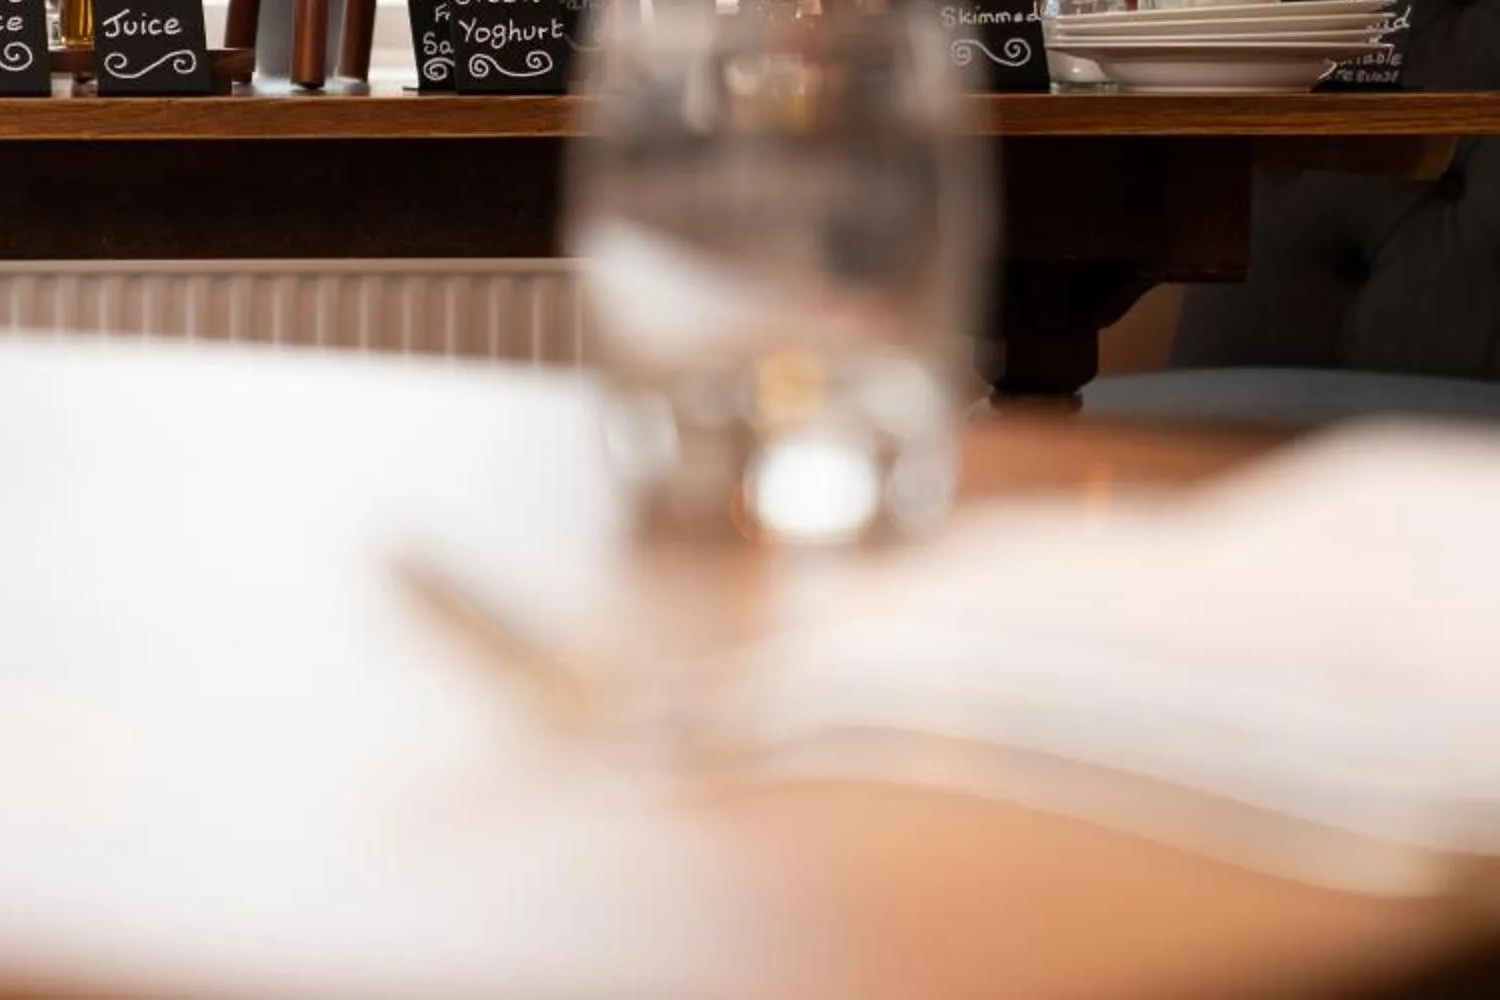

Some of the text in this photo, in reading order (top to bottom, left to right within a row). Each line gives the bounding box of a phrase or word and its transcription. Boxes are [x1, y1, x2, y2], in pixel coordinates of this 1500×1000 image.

[102, 8, 183, 38] Juice
[940, 0, 1042, 30] Skimmed
[457, 17, 565, 50] Yoghurt
